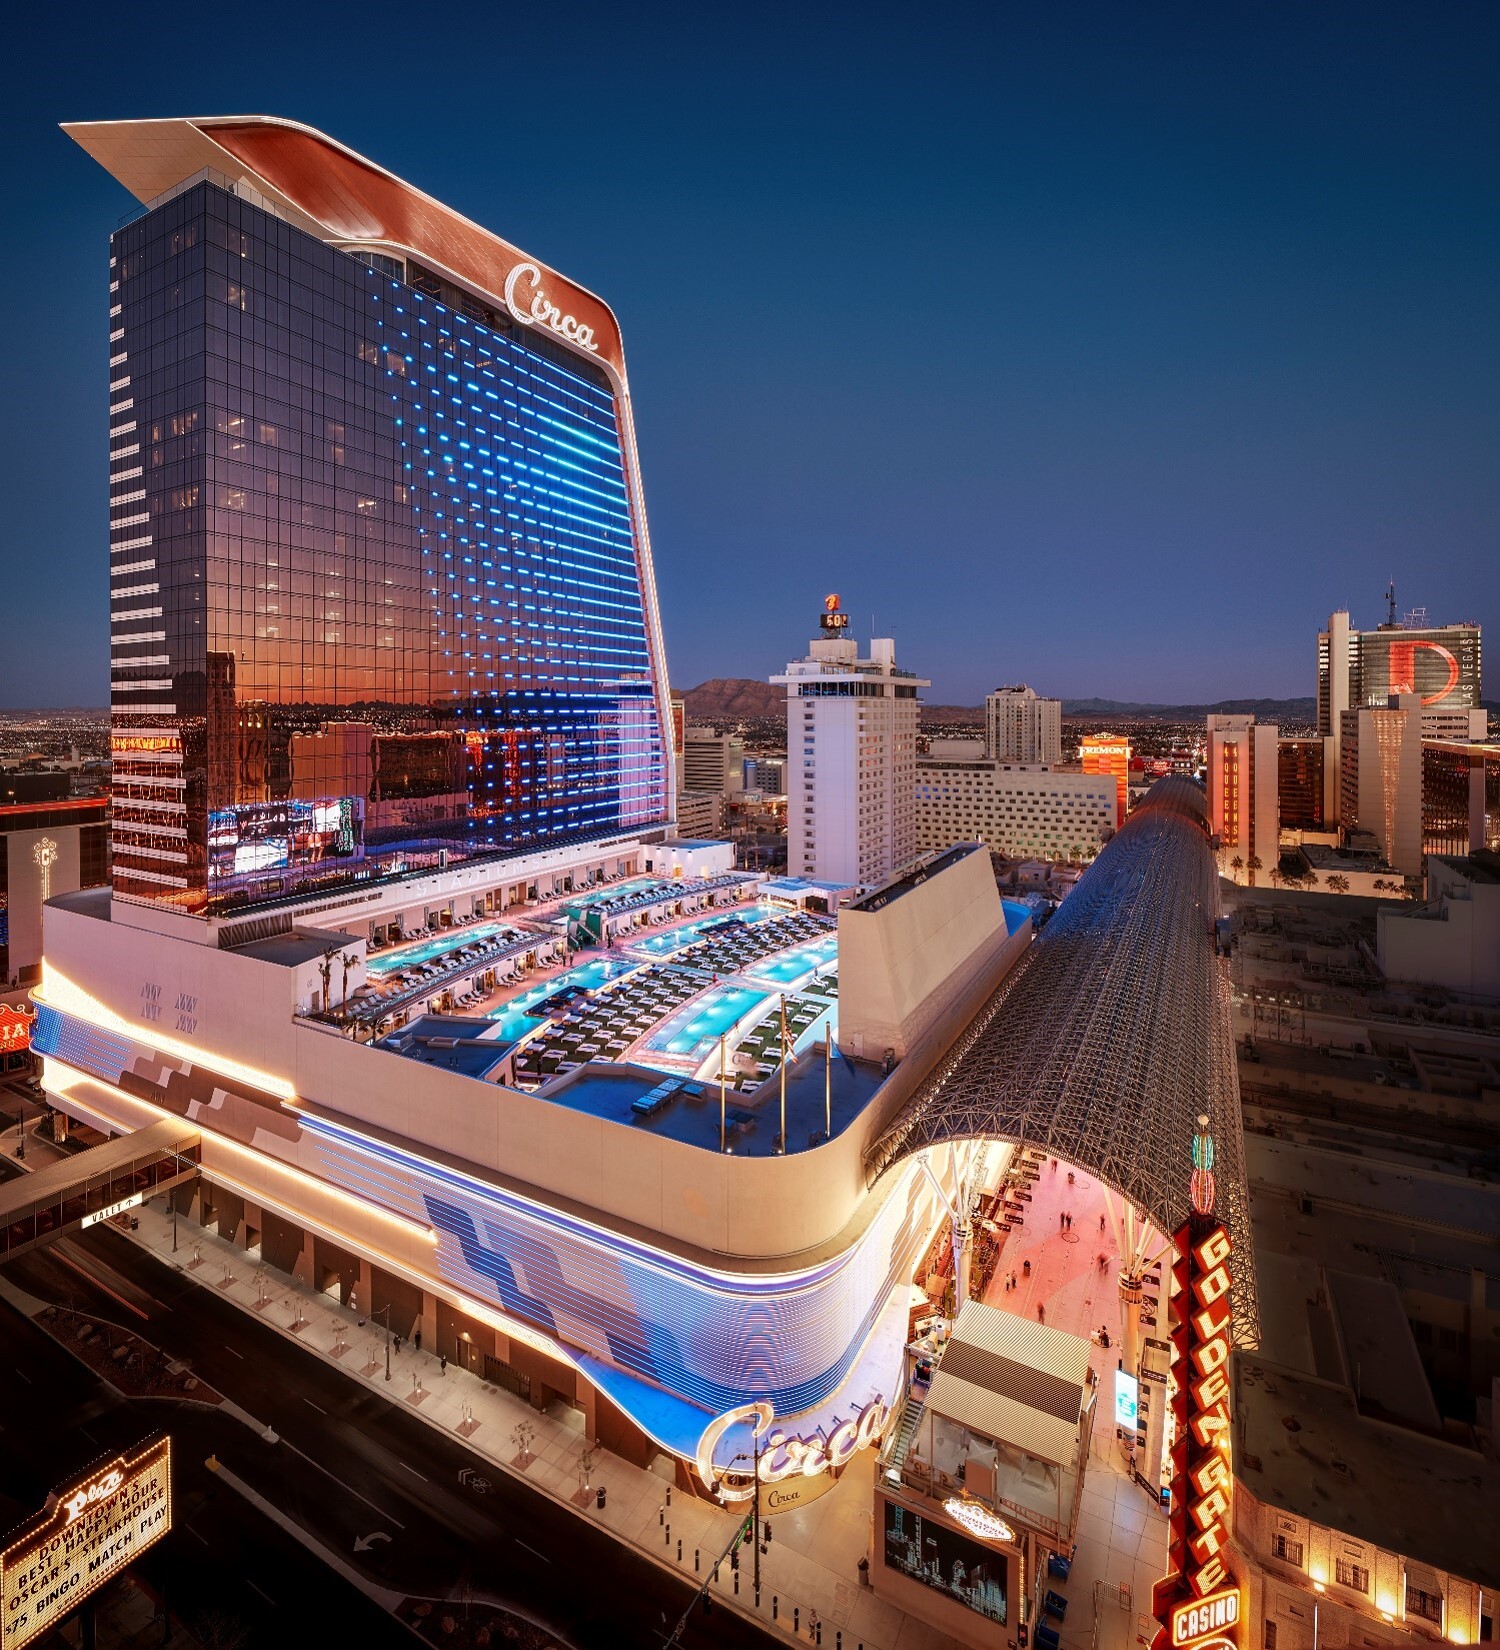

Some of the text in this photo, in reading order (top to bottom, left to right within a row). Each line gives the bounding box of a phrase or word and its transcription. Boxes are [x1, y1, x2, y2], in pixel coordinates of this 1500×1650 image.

[504, 262, 598, 350] Circa
[1368, 640, 1460, 706] the D
[1461, 637, 1474, 706] LAS VEGAS
[1076, 745, 1134, 760] FREMONT
[1224, 746, 1229, 757] 4
[1233, 746, 1238, 757] 4
[416, 861, 523, 897] STADIUM
[92, 1203, 122, 1222] VALET
[1195, 1230, 1231, 1596] GOLDEN GATE
[696, 1394, 891, 1502] Circa
[64, 1469, 124, 1526] Plaza
[768, 1490, 800, 1508] Circa
[9, 1487, 164, 1611] OSCAR'S STEAKHOUSE
[19, 1478, 157, 1589] BEST HAPPY HOUR
[5, 1505, 167, 1635] $75 BINGO MATCH PLAY
[1177, 1595, 1237, 1641] CASINO
